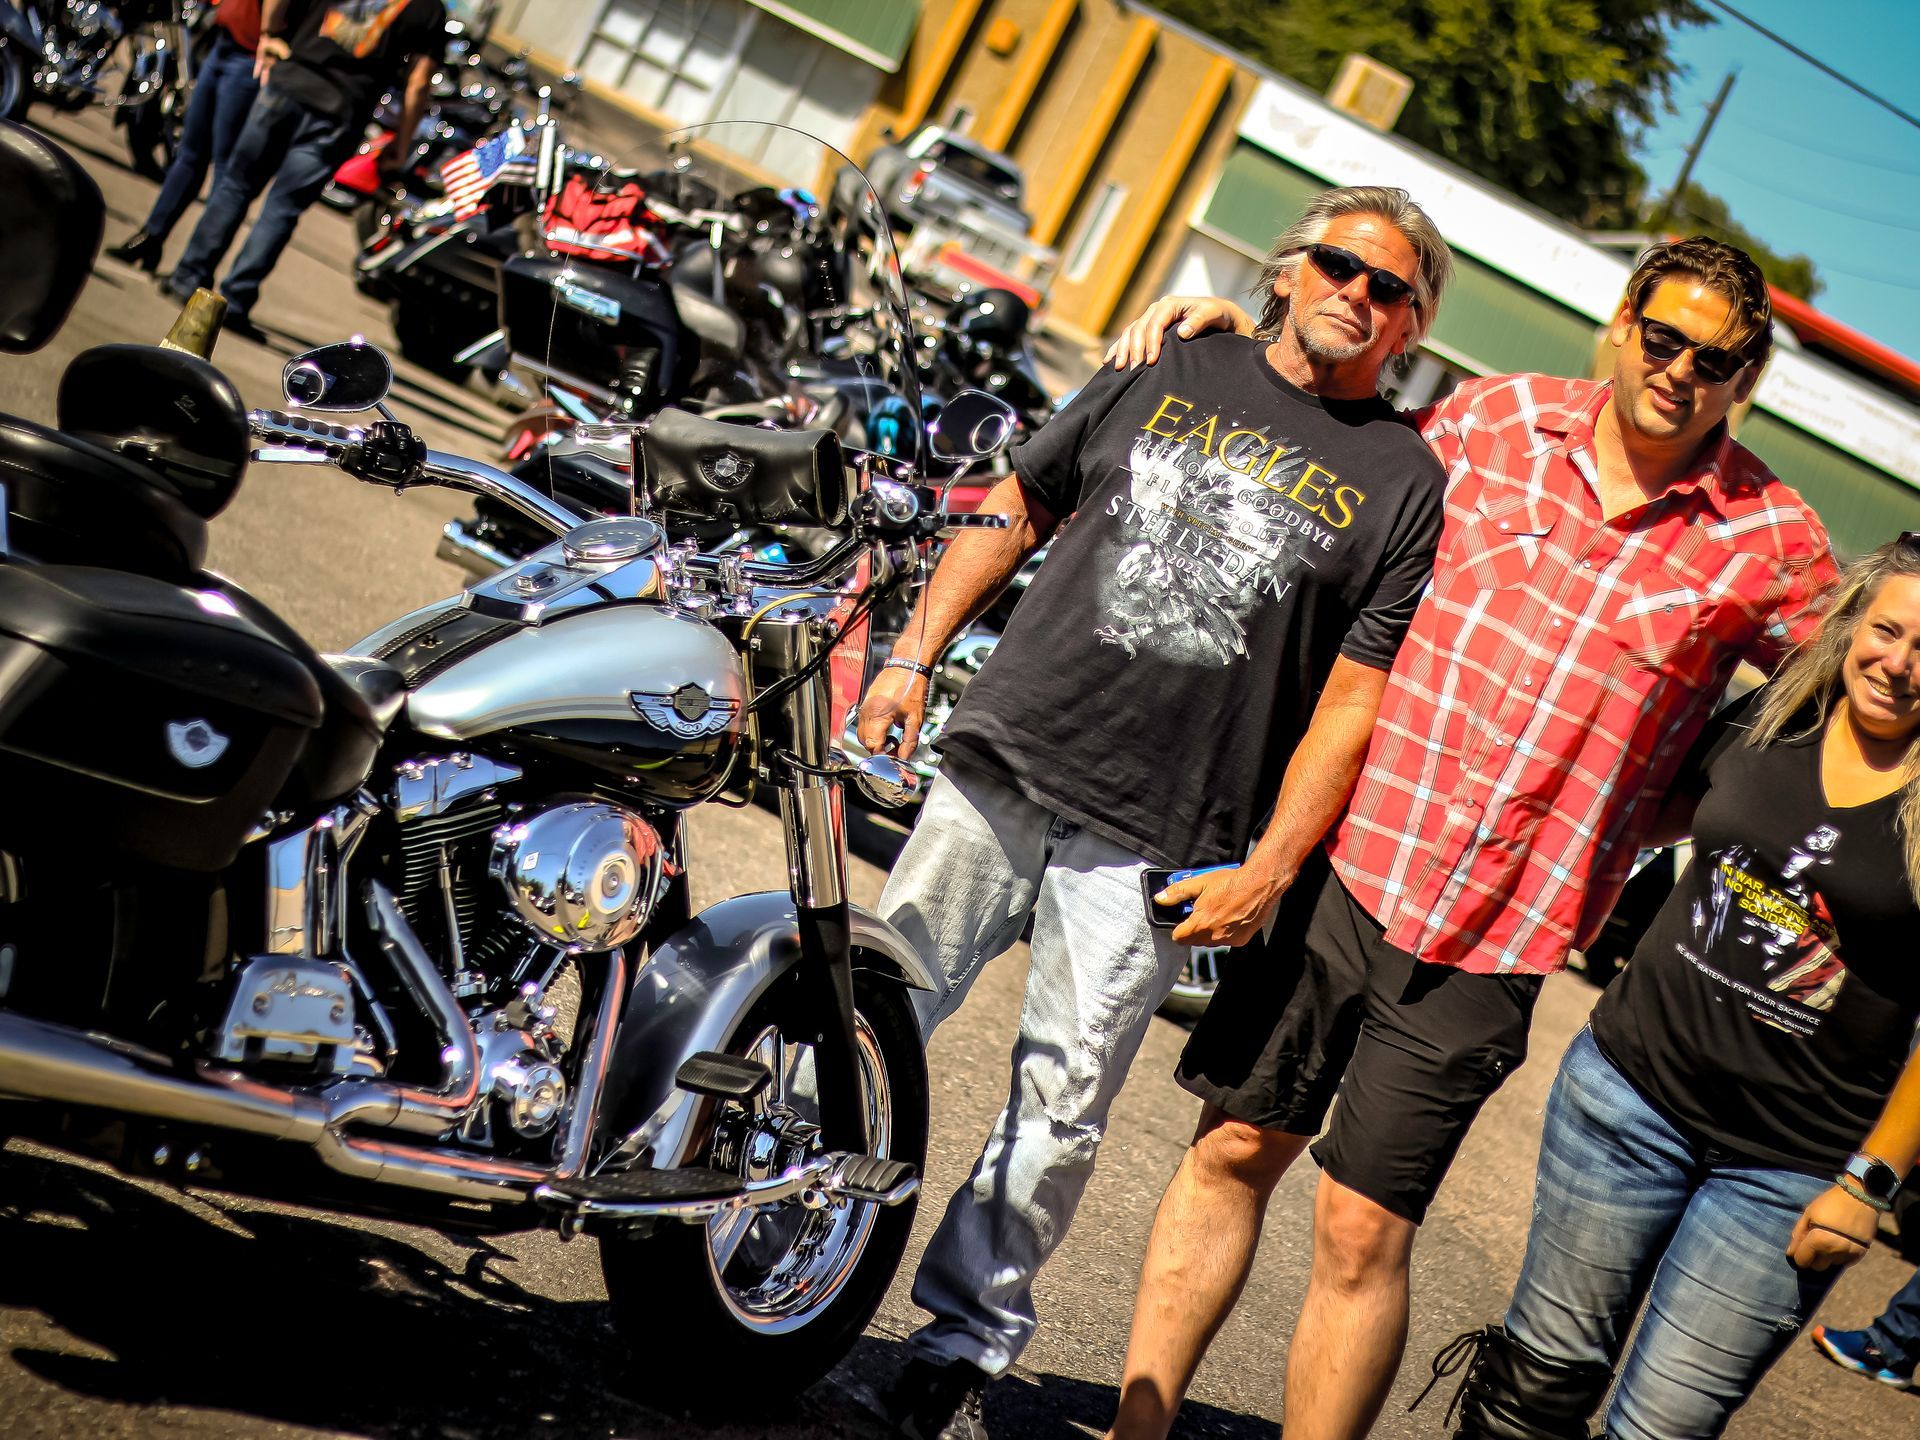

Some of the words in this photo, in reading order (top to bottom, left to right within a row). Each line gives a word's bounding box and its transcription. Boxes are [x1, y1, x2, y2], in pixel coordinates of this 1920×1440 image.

[1140, 394, 1366, 530] EAGLES
[1133, 436, 1172, 462] THE
[1172, 454, 1234, 495] LONG
[1237, 488, 1335, 552] GOODBYE
[1146, 472, 1212, 515] FINAL
[1226, 513, 1286, 552] TOUR
[1105, 495, 1213, 557] STEELY
[1220, 550, 1292, 603] DAN
[1160, 502, 1185, 519] WITH
[1186, 514, 1224, 538] SPECIAL
[1225, 535, 1258, 554] GUEST
[1168, 553, 1203, 577] 2023
[1720, 863, 1734, 877] IN
[1725, 878, 1743, 893] NO
[1683, 951, 1698, 965] ARE
[1733, 982, 1751, 996] FOR
[1753, 991, 1776, 1008] YOUR
[1777, 1004, 1821, 1026] SACRIFICE
[1747, 1002, 1774, 1018] PROJECT
